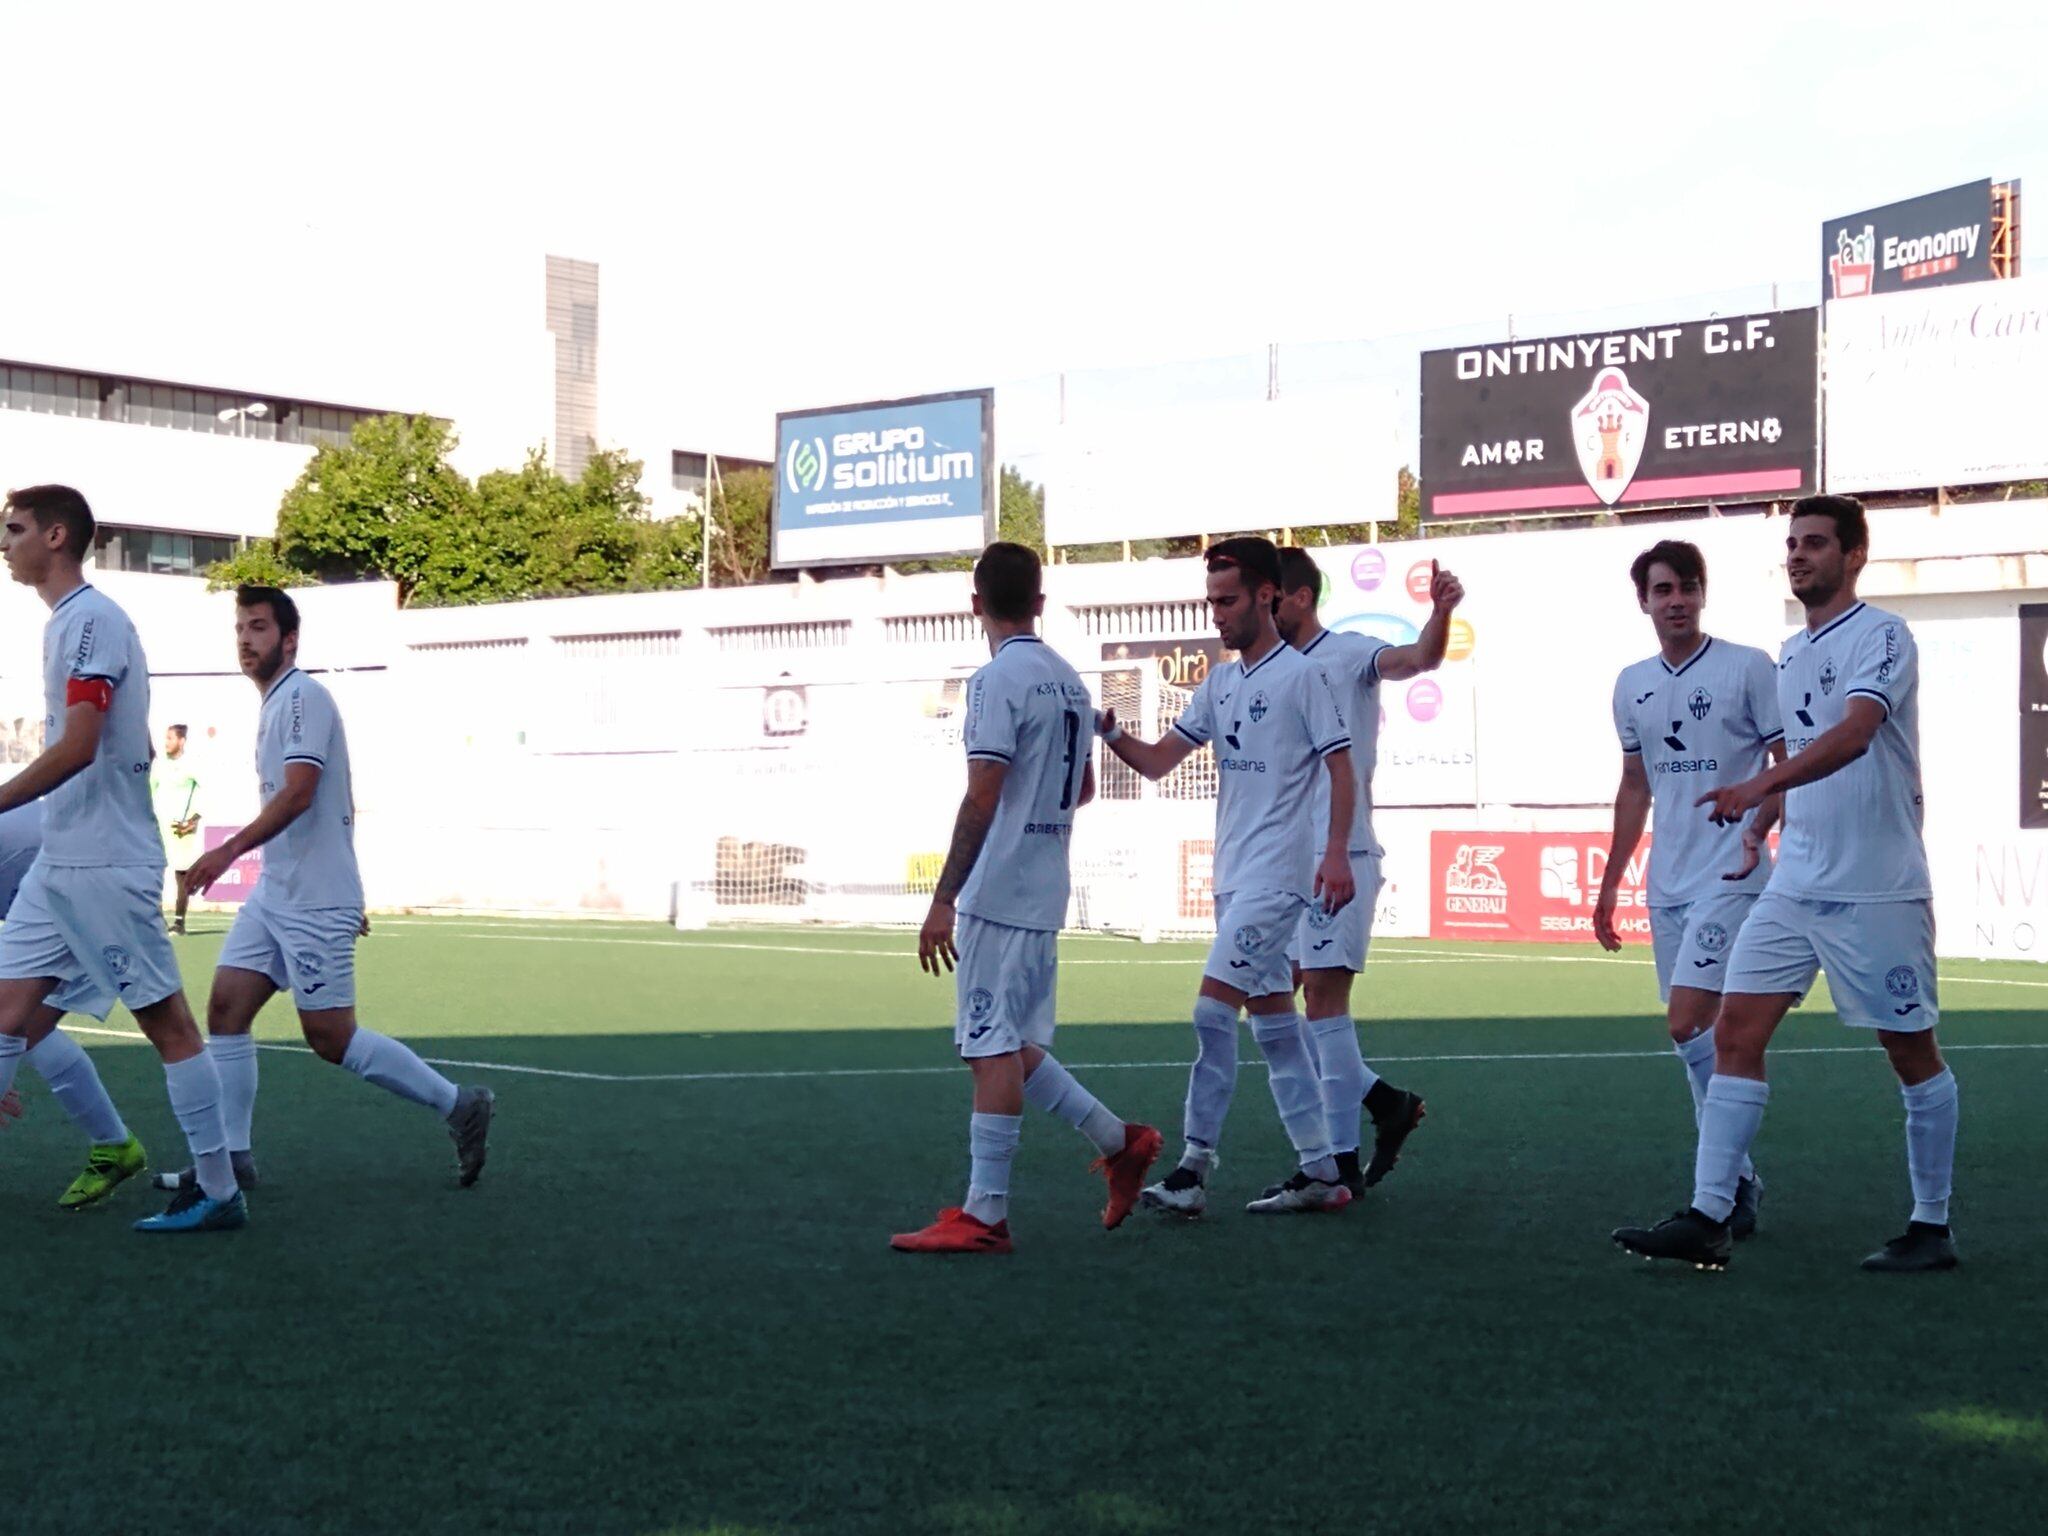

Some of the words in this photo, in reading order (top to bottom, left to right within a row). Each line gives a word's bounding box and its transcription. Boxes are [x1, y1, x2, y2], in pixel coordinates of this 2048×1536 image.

[1883, 224, 1980, 271] Economy
[1908, 258, 1953, 279] CASH
[1457, 329, 1682, 380] ONTINYENT
[1704, 319, 1775, 354] C.F.
[833, 426, 924, 456] GRUPO
[833, 451, 974, 490] solitium
[1446, 895, 1507, 914] GENERALI
